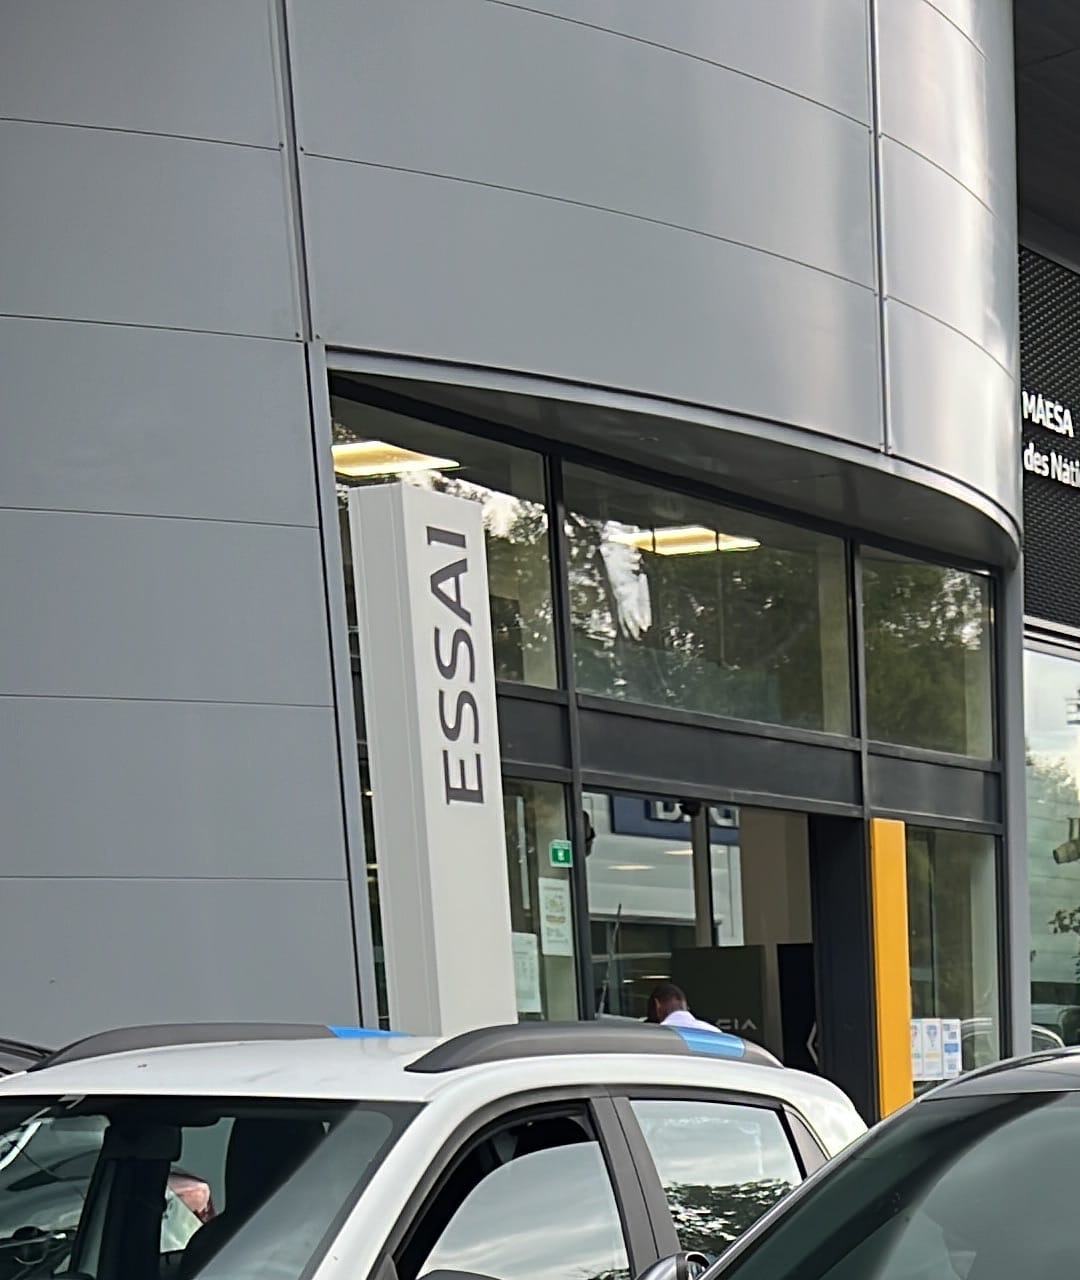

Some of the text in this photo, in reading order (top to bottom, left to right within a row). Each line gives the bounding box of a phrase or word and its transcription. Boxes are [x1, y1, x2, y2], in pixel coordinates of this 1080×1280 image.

[1022, 391, 1074, 438] MAESA
[1024, 442, 1049, 477] des
[426, 525, 484, 806] ESSAI
